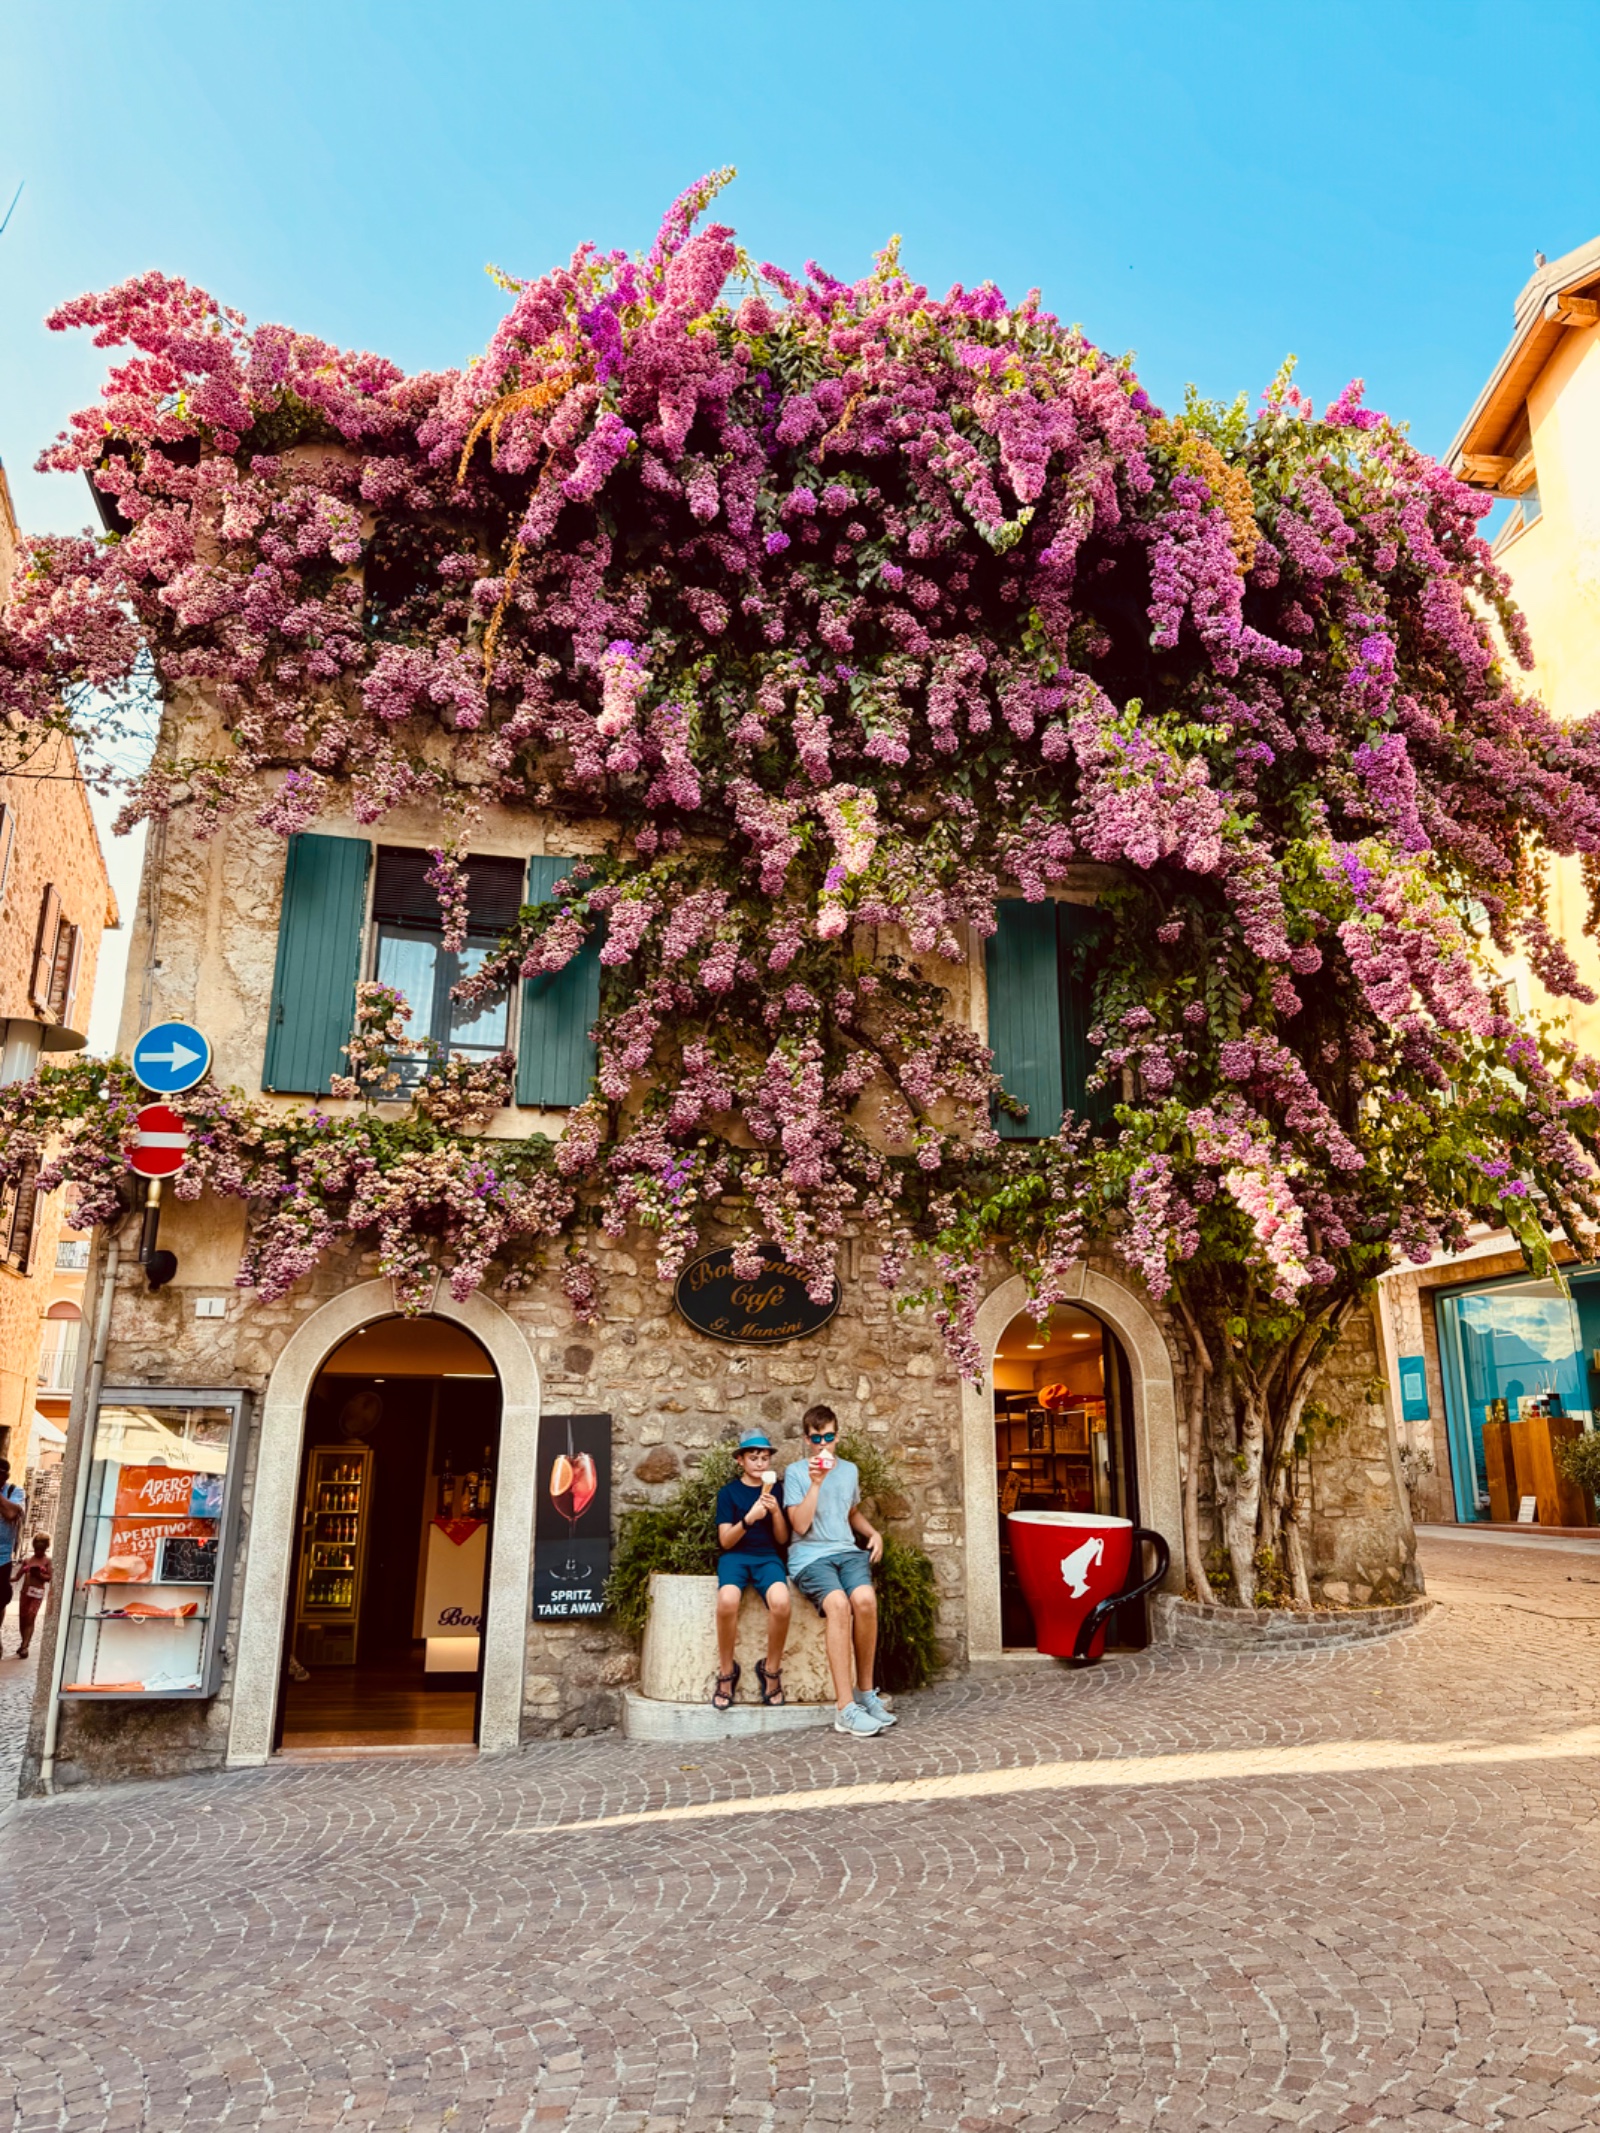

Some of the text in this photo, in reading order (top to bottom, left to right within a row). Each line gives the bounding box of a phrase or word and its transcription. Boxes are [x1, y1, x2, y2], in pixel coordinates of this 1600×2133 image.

[731, 1318, 804, 1338] Mancini
[148, 1489, 188, 1507] SPRITZ
[113, 1521, 187, 1545] APERITIVO
[550, 1589, 593, 1602] SPRITZ
[537, 1602, 605, 1616] TAKE AWAY
